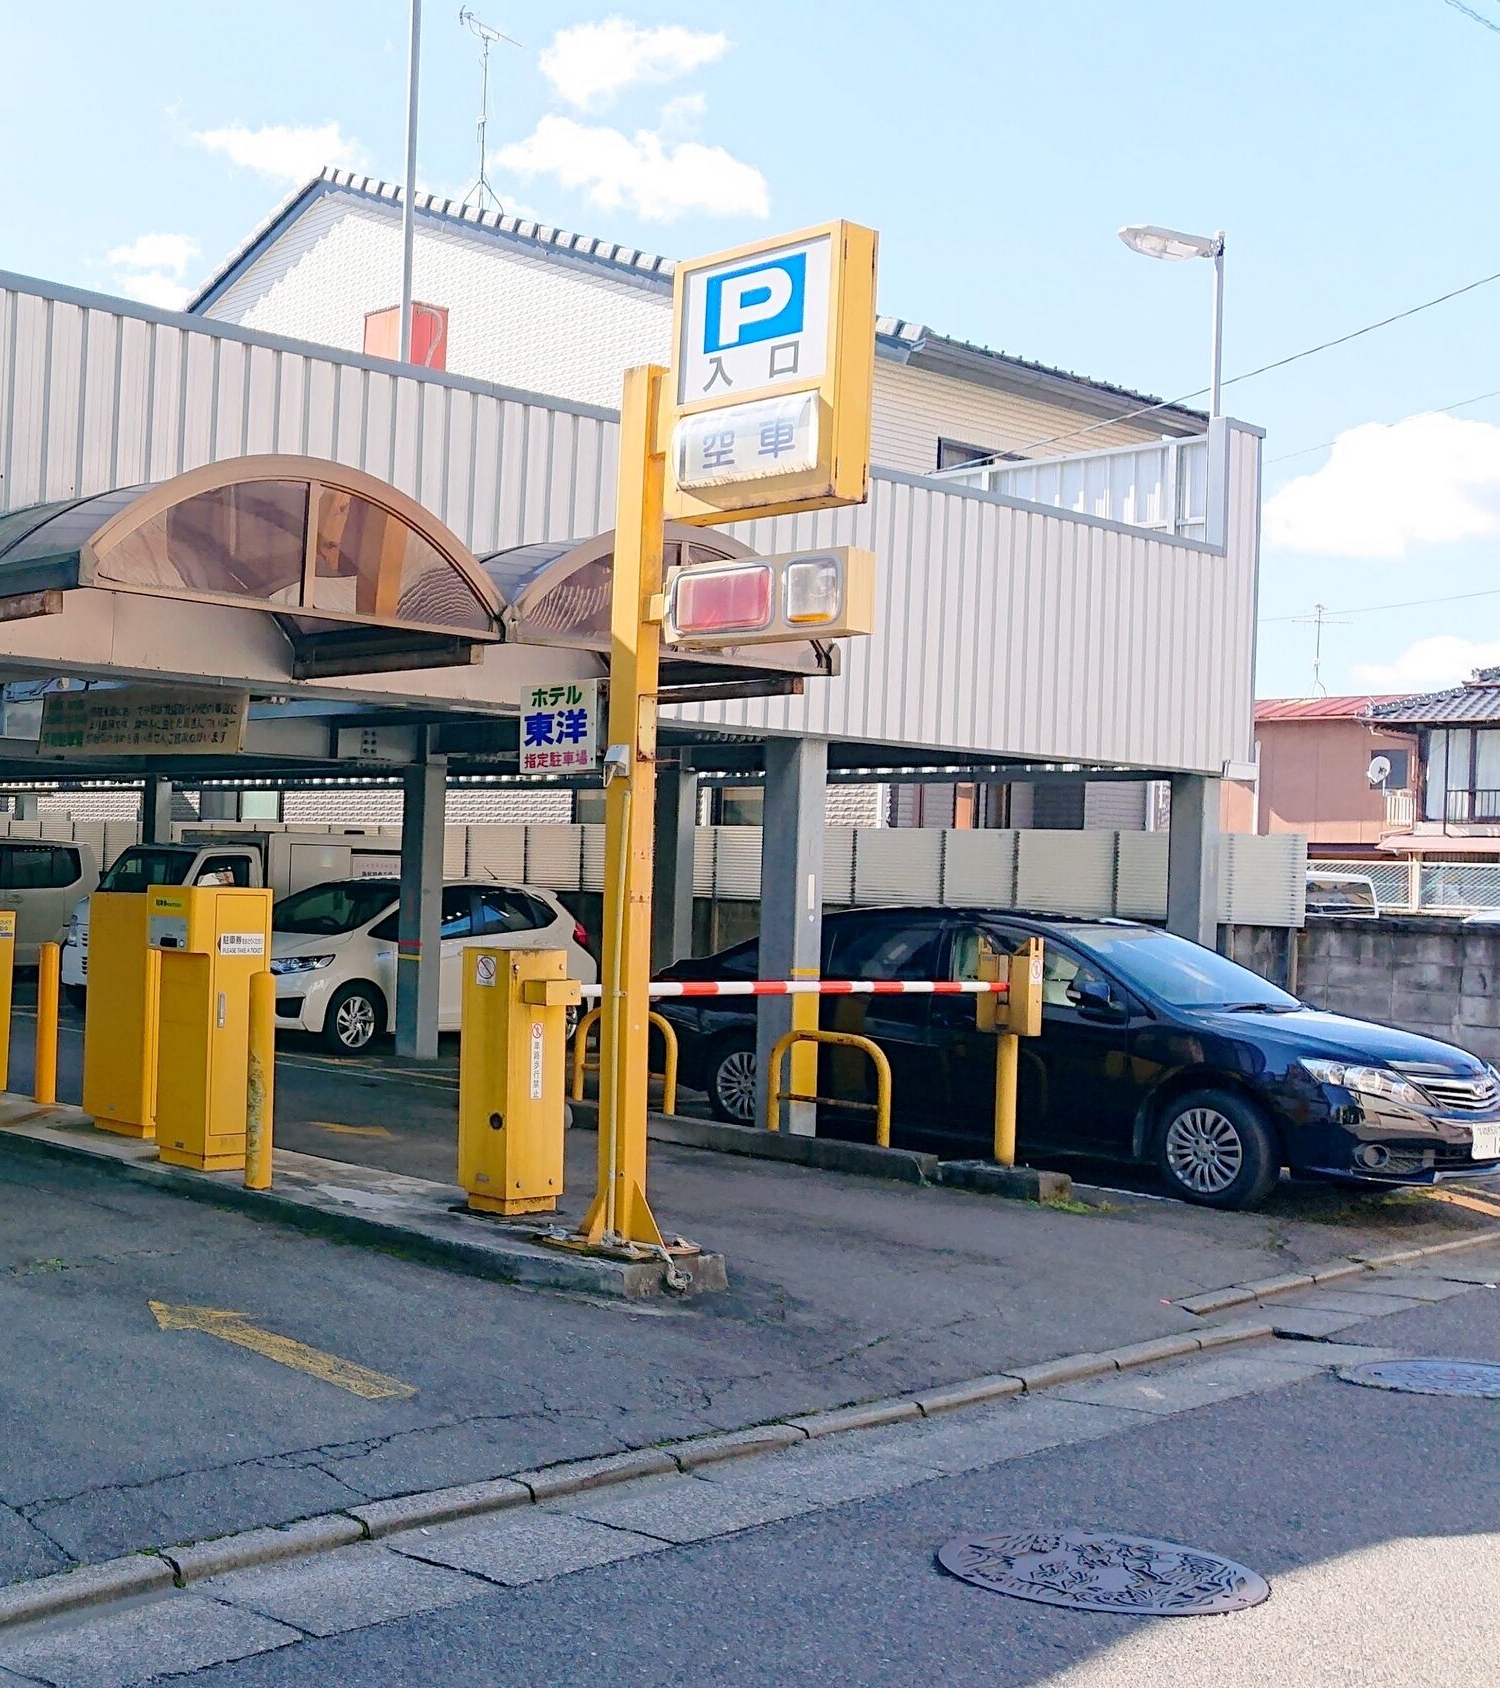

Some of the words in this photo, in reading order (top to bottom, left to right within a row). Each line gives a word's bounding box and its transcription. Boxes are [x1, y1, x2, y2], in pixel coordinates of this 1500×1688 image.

[718, 267, 793, 347] P
[703, 340, 800, 393] 入口
[702, 416, 796, 470] 空車
[531, 685, 583, 707] ホテル
[524, 708, 588, 747] 東洋
[524, 749, 588, 769] 指定駐車場
